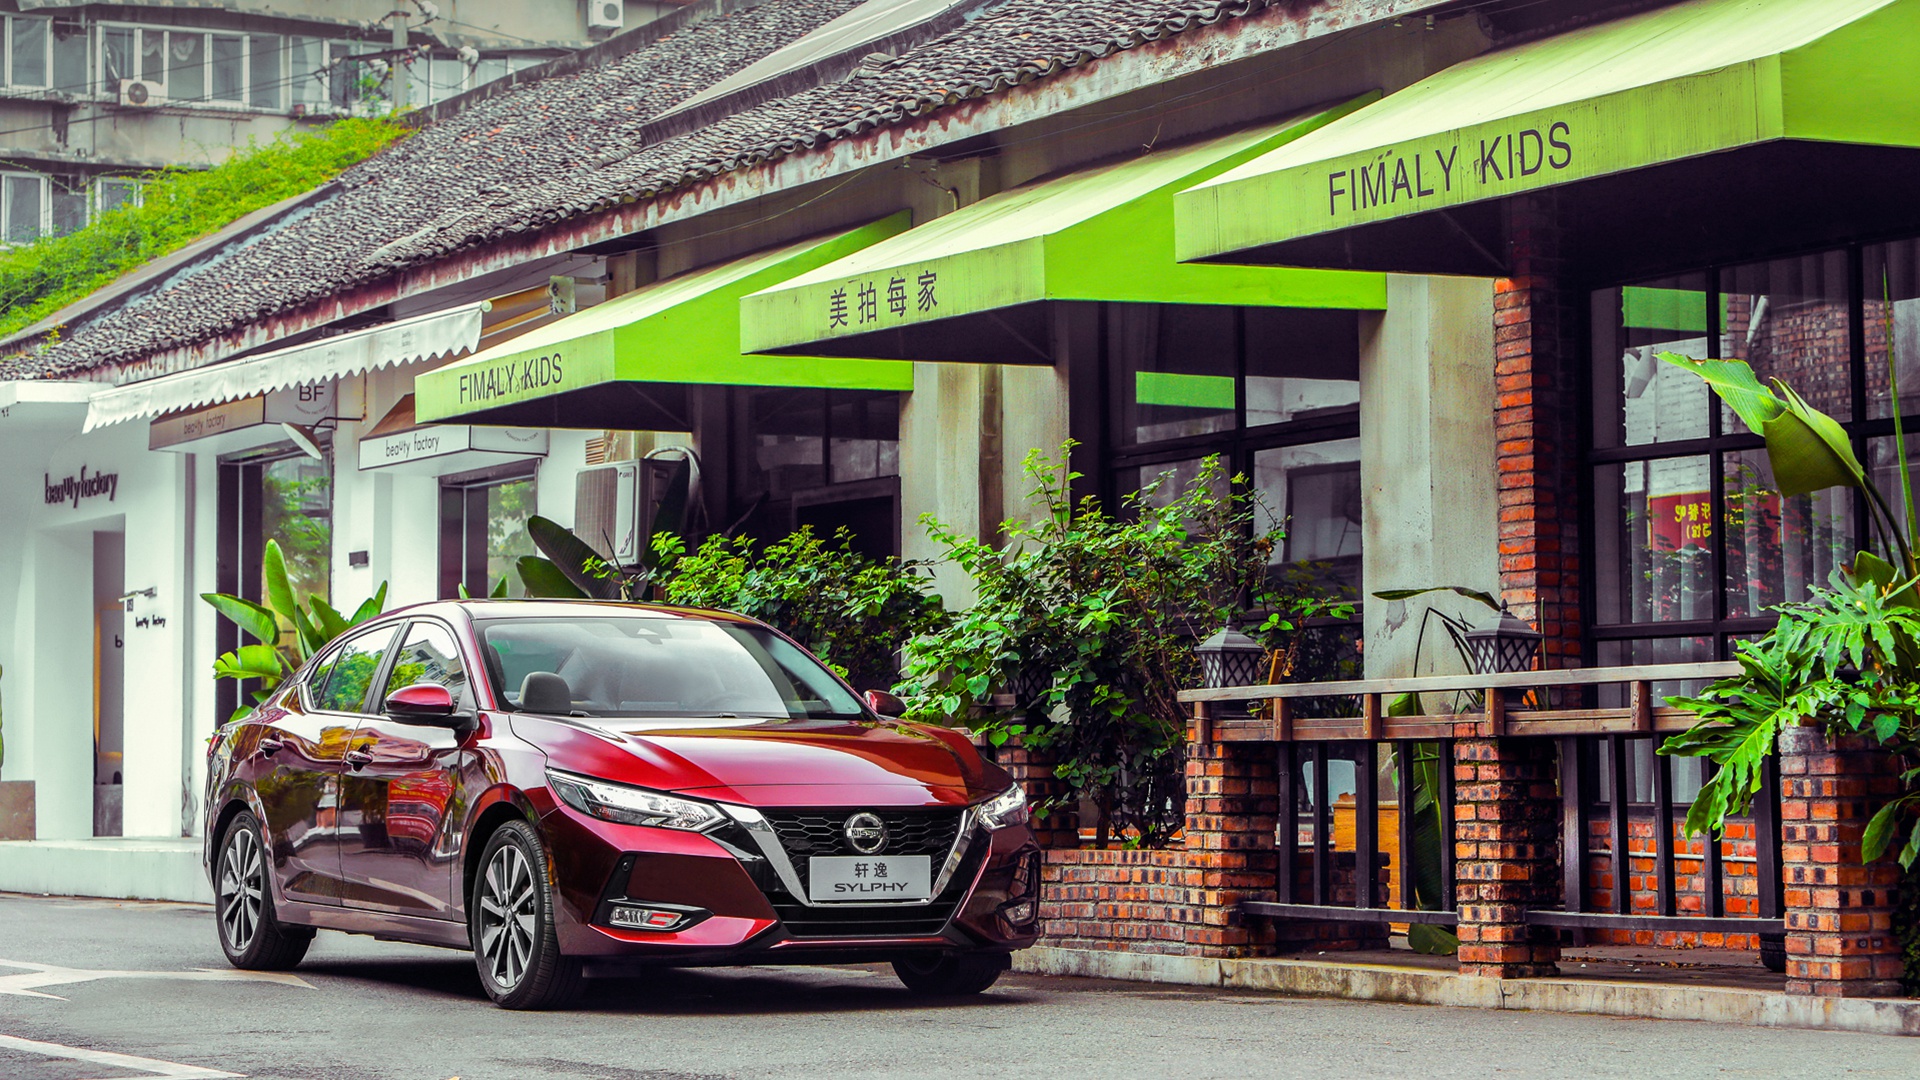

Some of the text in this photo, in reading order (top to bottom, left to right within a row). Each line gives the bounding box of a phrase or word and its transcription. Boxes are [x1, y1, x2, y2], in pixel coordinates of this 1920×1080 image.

[1329, 121, 1572, 216] FIMALY KIDS
[830, 270, 938, 329] 美拍每家
[460, 353, 562, 404] FIMALY KIDS
[299, 385, 325, 402] BF
[386, 432, 440, 458] beauty factory
[854, 862, 888, 879] 轩逸
[834, 882, 908, 893] SYLPHY
